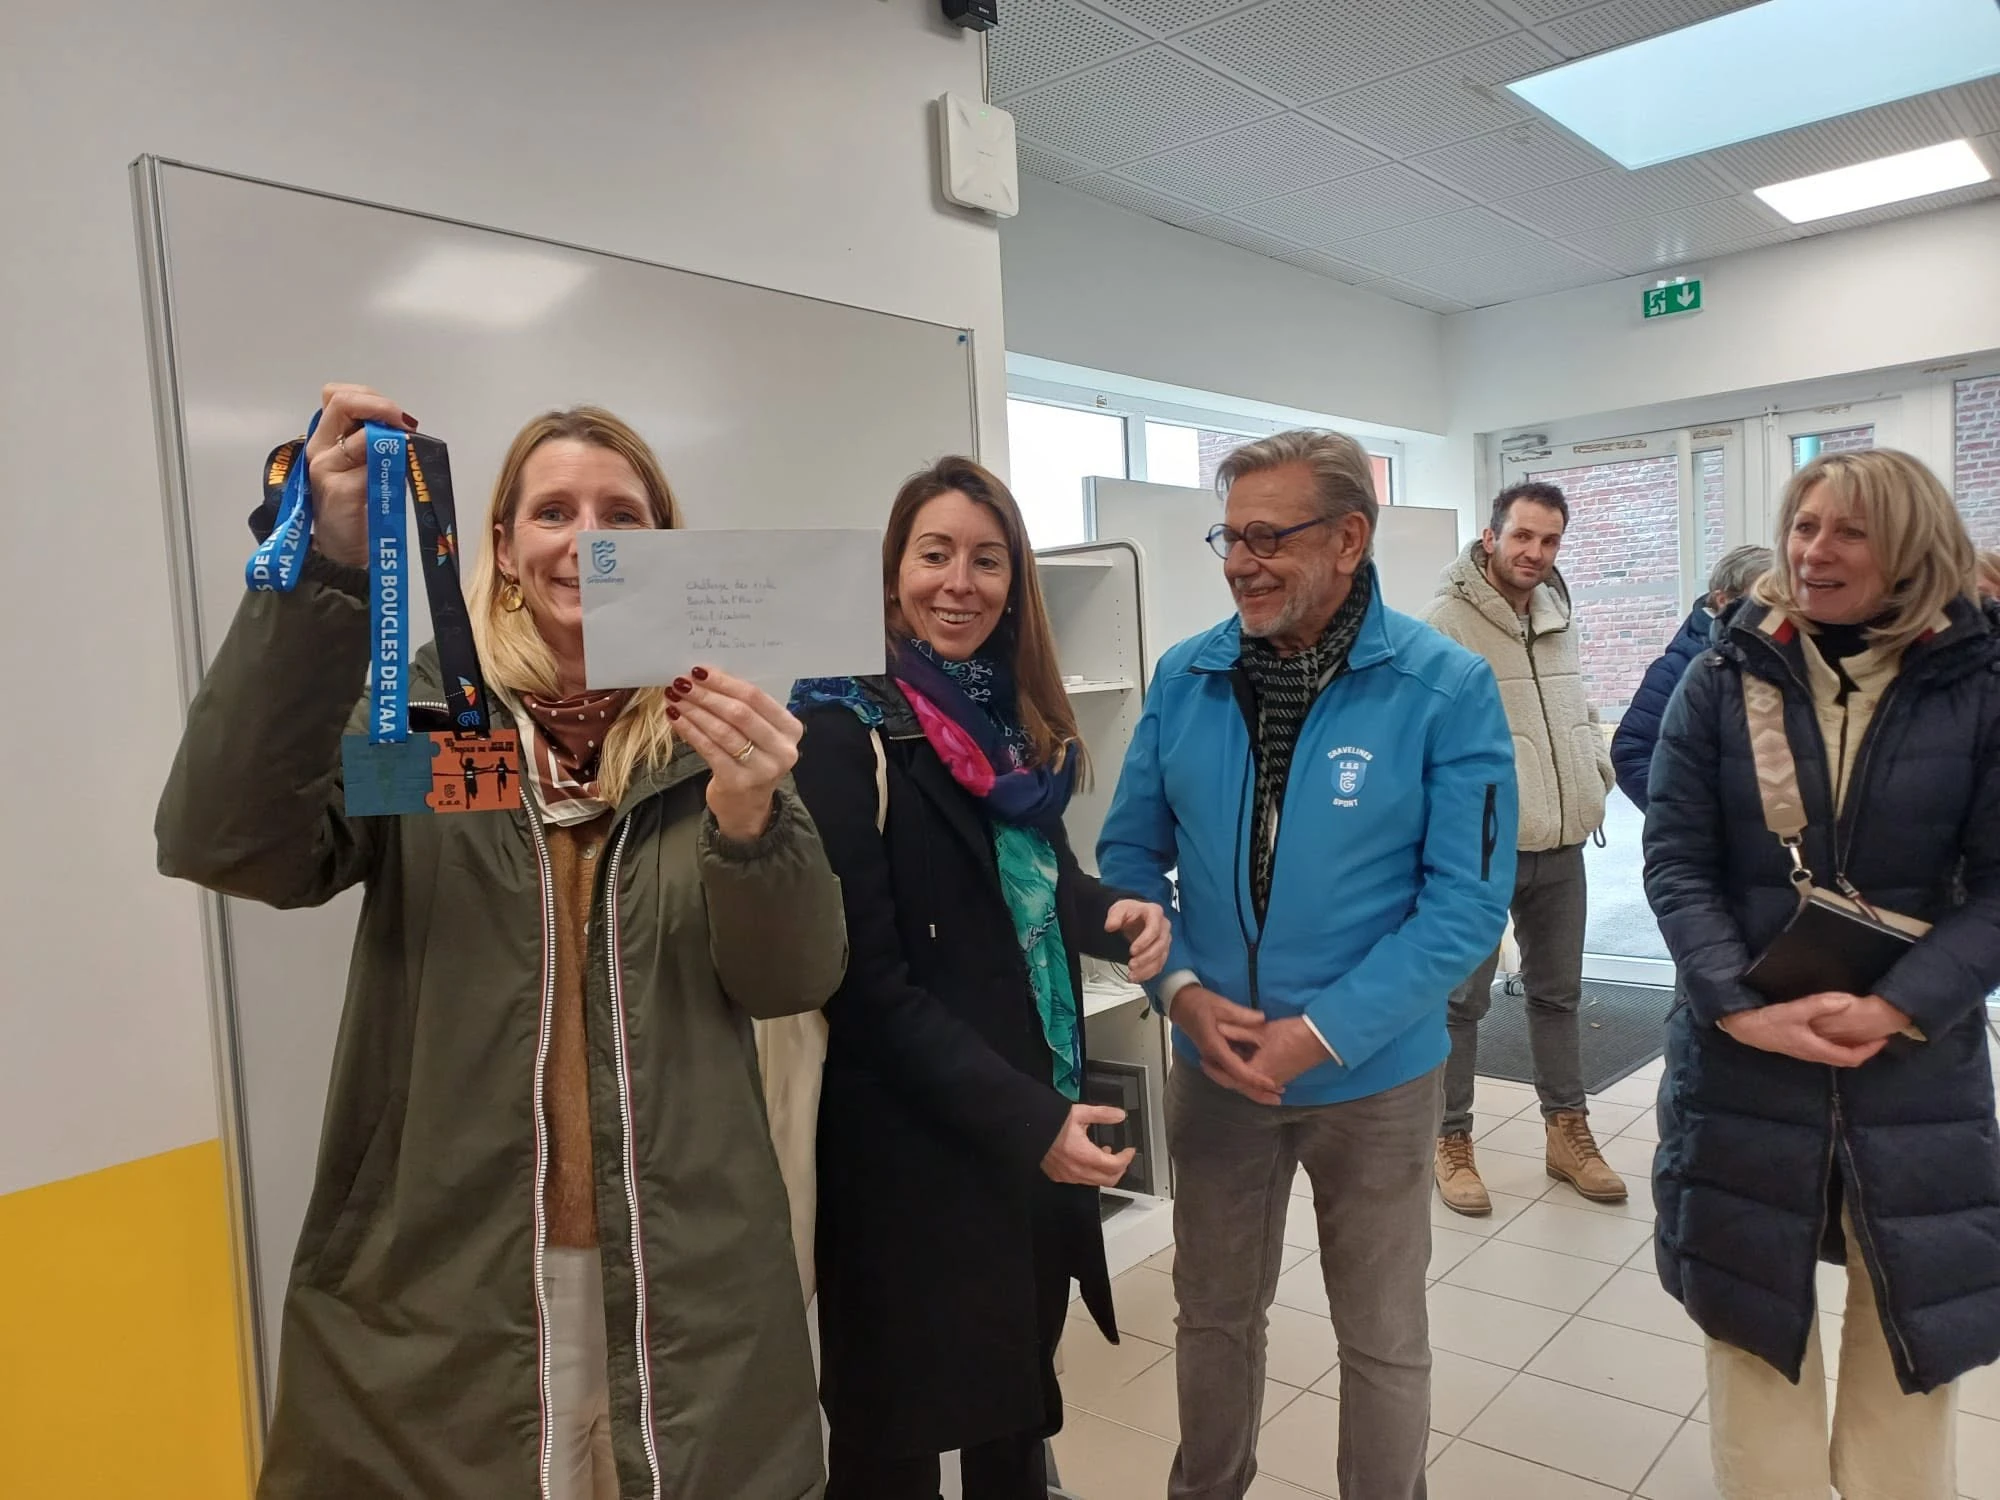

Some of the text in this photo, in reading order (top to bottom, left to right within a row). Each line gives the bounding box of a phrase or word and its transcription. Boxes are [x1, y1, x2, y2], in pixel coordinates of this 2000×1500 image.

[267, 443, 296, 485] AUBAN
[380, 458, 392, 515] Gravelines
[253, 555, 270, 580] DE
[379, 537, 397, 570] LES
[380, 575, 398, 661] BOUCLES
[380, 666, 397, 691] DE
[378, 696, 397, 735] L'AA
[1327, 746, 1373, 761] GRAVELINES
[1333, 798, 1359, 808] SPORT
